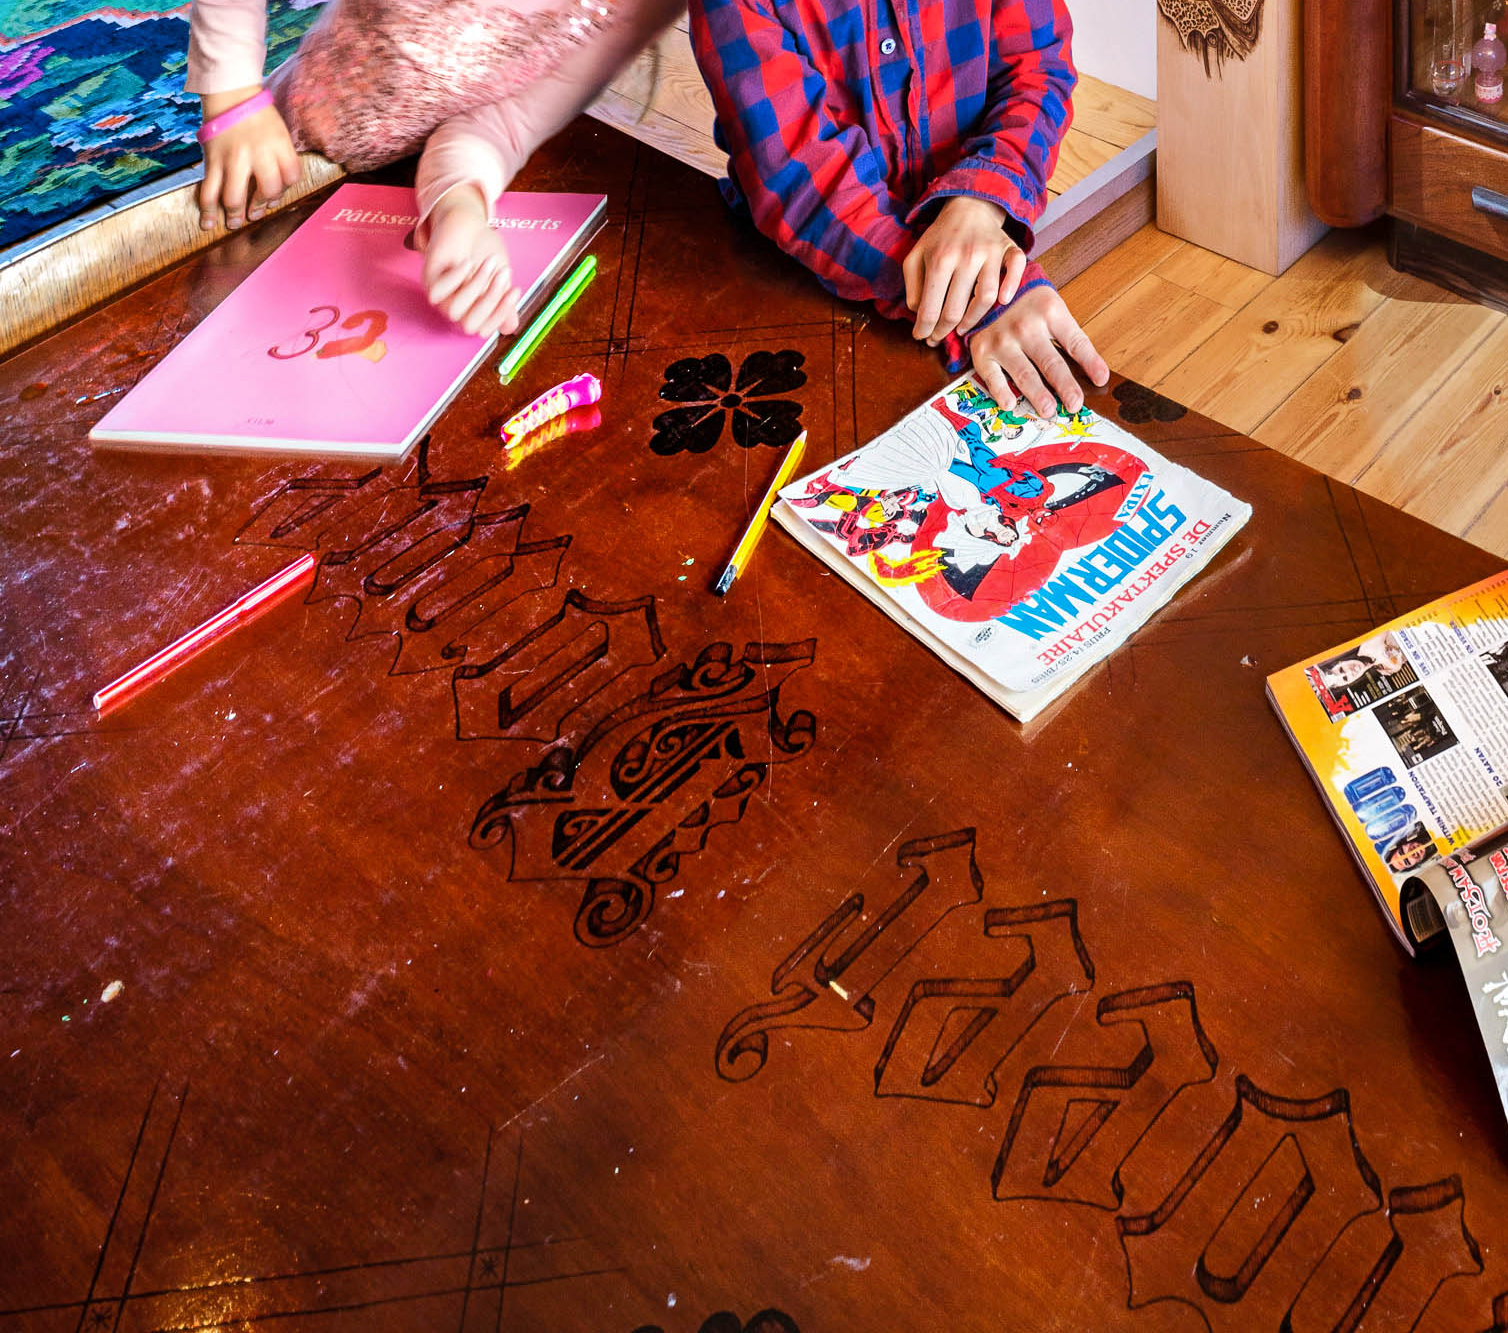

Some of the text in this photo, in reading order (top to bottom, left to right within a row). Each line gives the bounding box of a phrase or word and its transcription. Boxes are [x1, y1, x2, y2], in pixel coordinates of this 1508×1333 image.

[486, 216, 562, 231] esserts
[1115, 471, 1155, 521] EXTRA
[988, 488, 1188, 641] SPIDERMAN
[1035, 516, 1211, 668] DE SPEKTAKULAIRE
[1407, 769, 1438, 815] TEMPTATION
[1433, 814, 1456, 846] WITHIN
[1487, 850, 1508, 875] FOR
